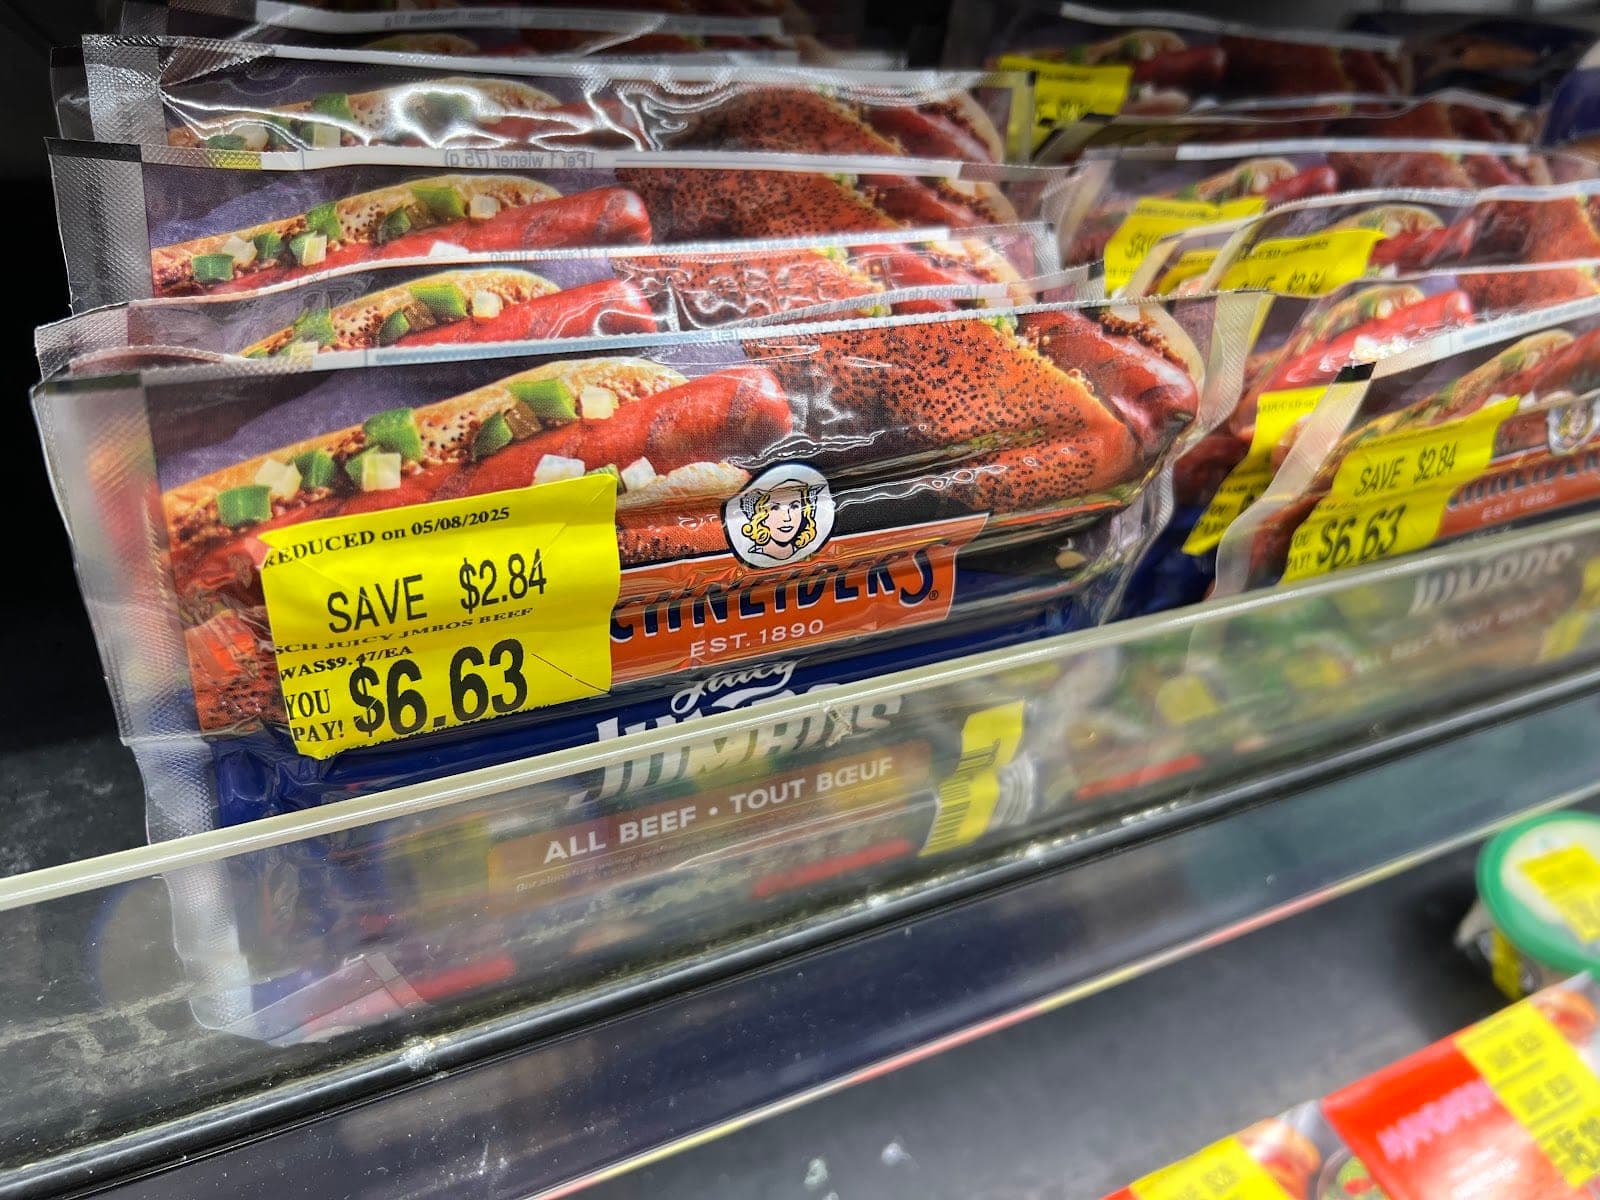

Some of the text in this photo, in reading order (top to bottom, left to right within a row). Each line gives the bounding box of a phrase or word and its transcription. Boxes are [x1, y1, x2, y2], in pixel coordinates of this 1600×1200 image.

[1354, 457, 1404, 496] SAVE
[1413, 441, 1457, 485] $2.84
[382, 528, 406, 542] on
[411, 507, 510, 535] 05/08/2025
[1317, 504, 1407, 570] $6.63
[327, 548, 547, 633] SAVE $2.84
[276, 607, 533, 655] SCH JUICY JMBOS BEEF
[690, 619, 824, 658] EST. 1890
[287, 688, 331, 720] YOU
[349, 638, 528, 737] $6.63
[292, 719, 345, 742] PAY!
[543, 756, 895, 864] ALL BEEF TOUT BŒUF
